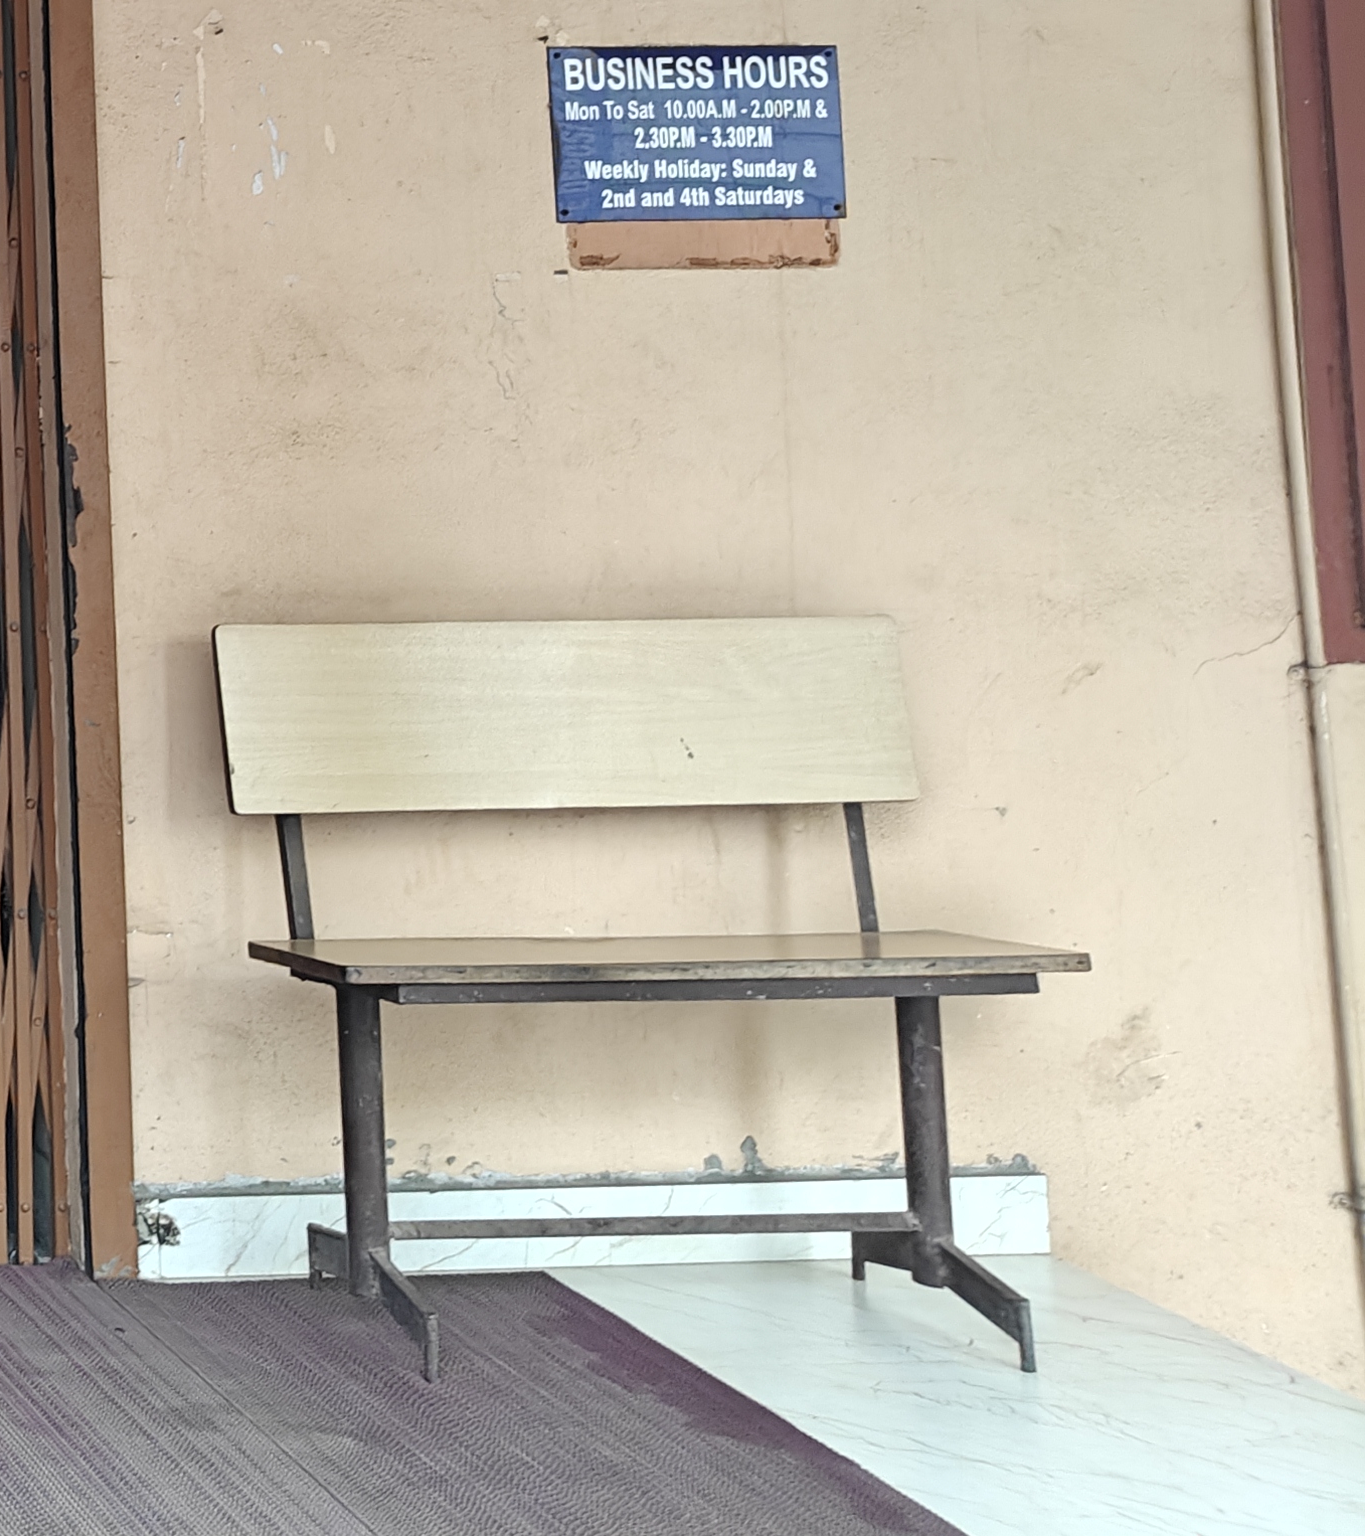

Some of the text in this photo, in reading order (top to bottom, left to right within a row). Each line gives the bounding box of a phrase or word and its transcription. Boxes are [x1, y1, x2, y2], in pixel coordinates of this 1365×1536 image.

[563, 55, 829, 91] BUSINESS HOURS
[565, 101, 600, 120] Mon
[602, 100, 625, 120] To
[627, 100, 655, 120] Sat
[664, 99, 737, 120] 10.00A.M
[750, 99, 811, 119] 2.00P.M
[815, 99, 828, 119] &
[634, 127, 696, 149] 2.30P.M
[711, 126, 773, 149] 3.30P.M
[584, 158, 817, 183] Weekly Holiday: Sunday &
[601, 185, 805, 209] 2nd and 4th Saturdays
